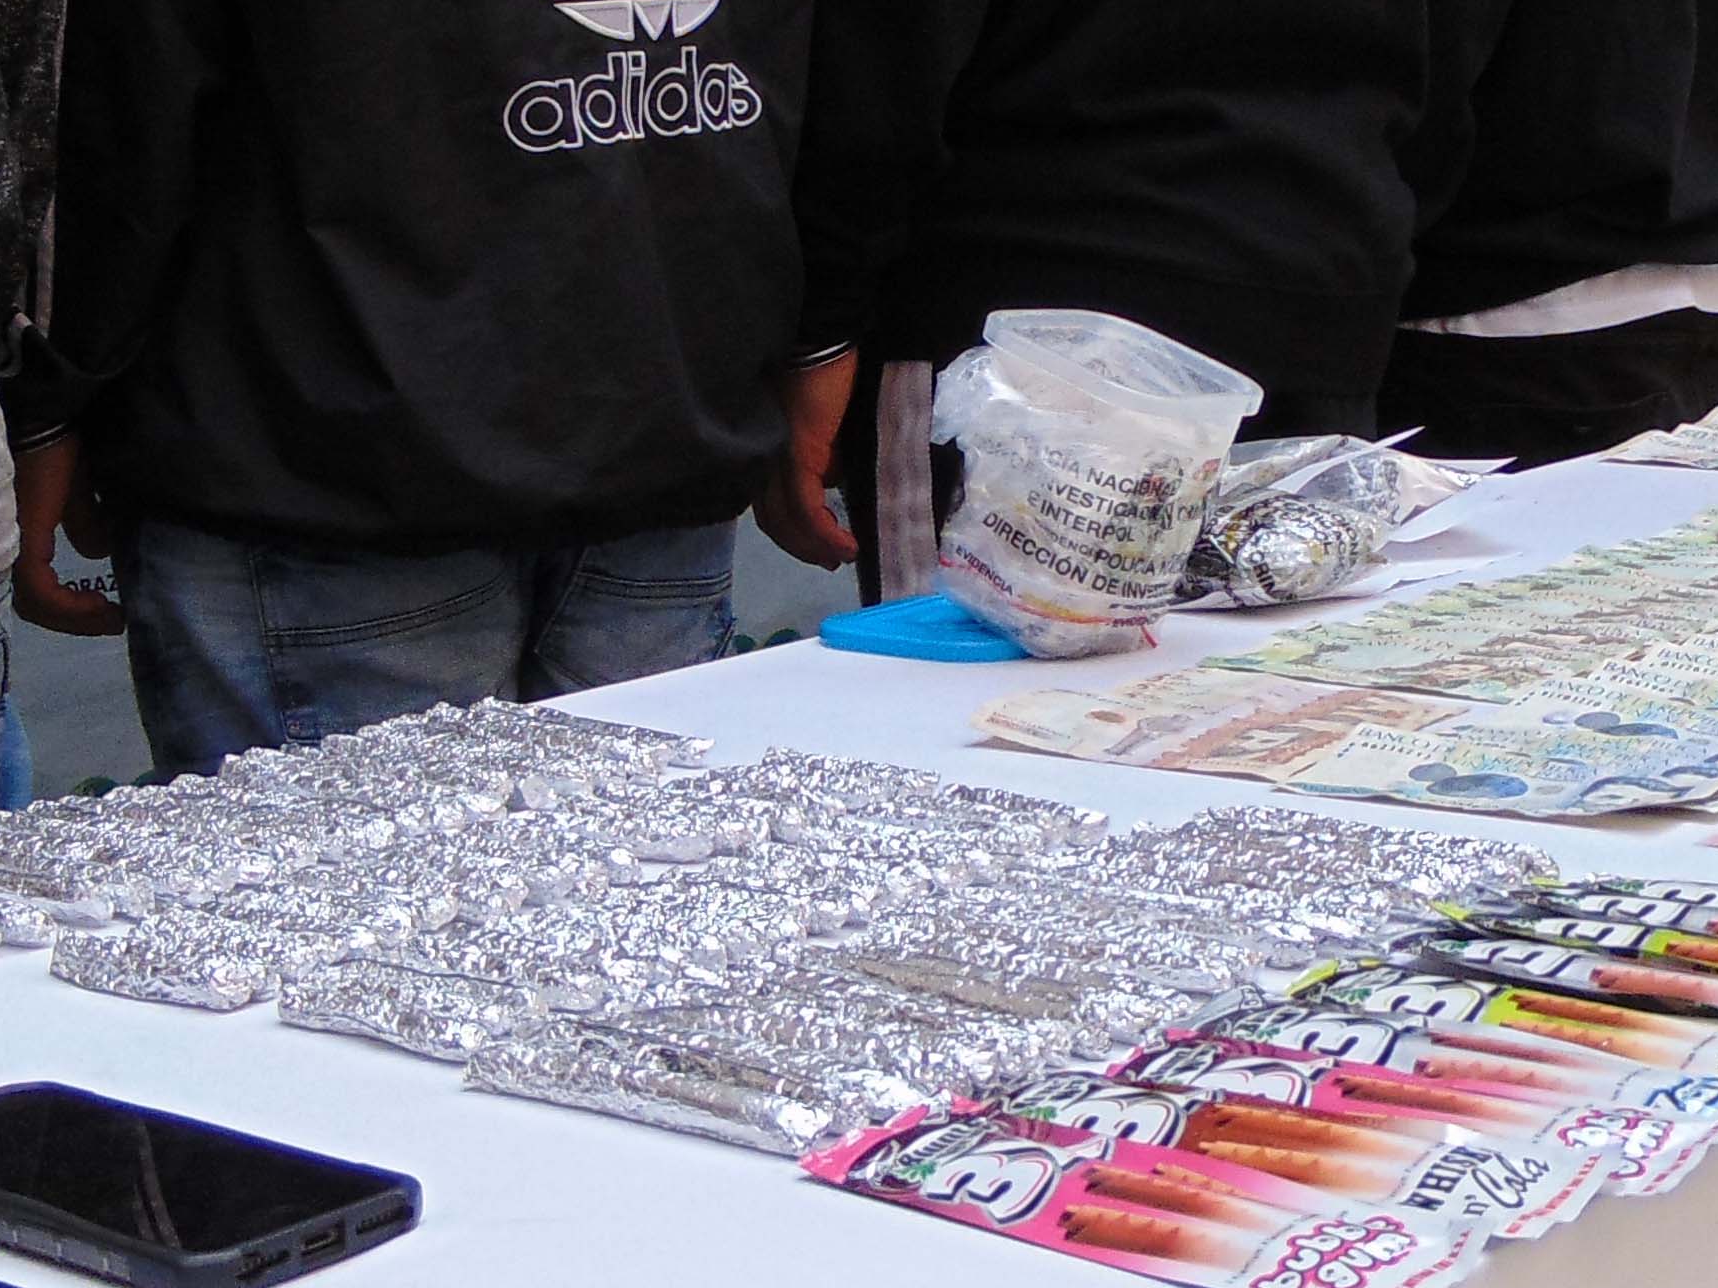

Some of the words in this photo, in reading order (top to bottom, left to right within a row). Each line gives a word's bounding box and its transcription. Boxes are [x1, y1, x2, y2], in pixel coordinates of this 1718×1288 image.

[503, 46, 763, 152] adidas
[1040, 499, 1135, 542] INTERPOL
[955, 544, 1014, 596] EVIDENCIA
[983, 513, 1089, 584] DIRECCIÓN
[1091, 574, 1118, 595] DE
[1470, 1150, 1551, 1210] Cola
